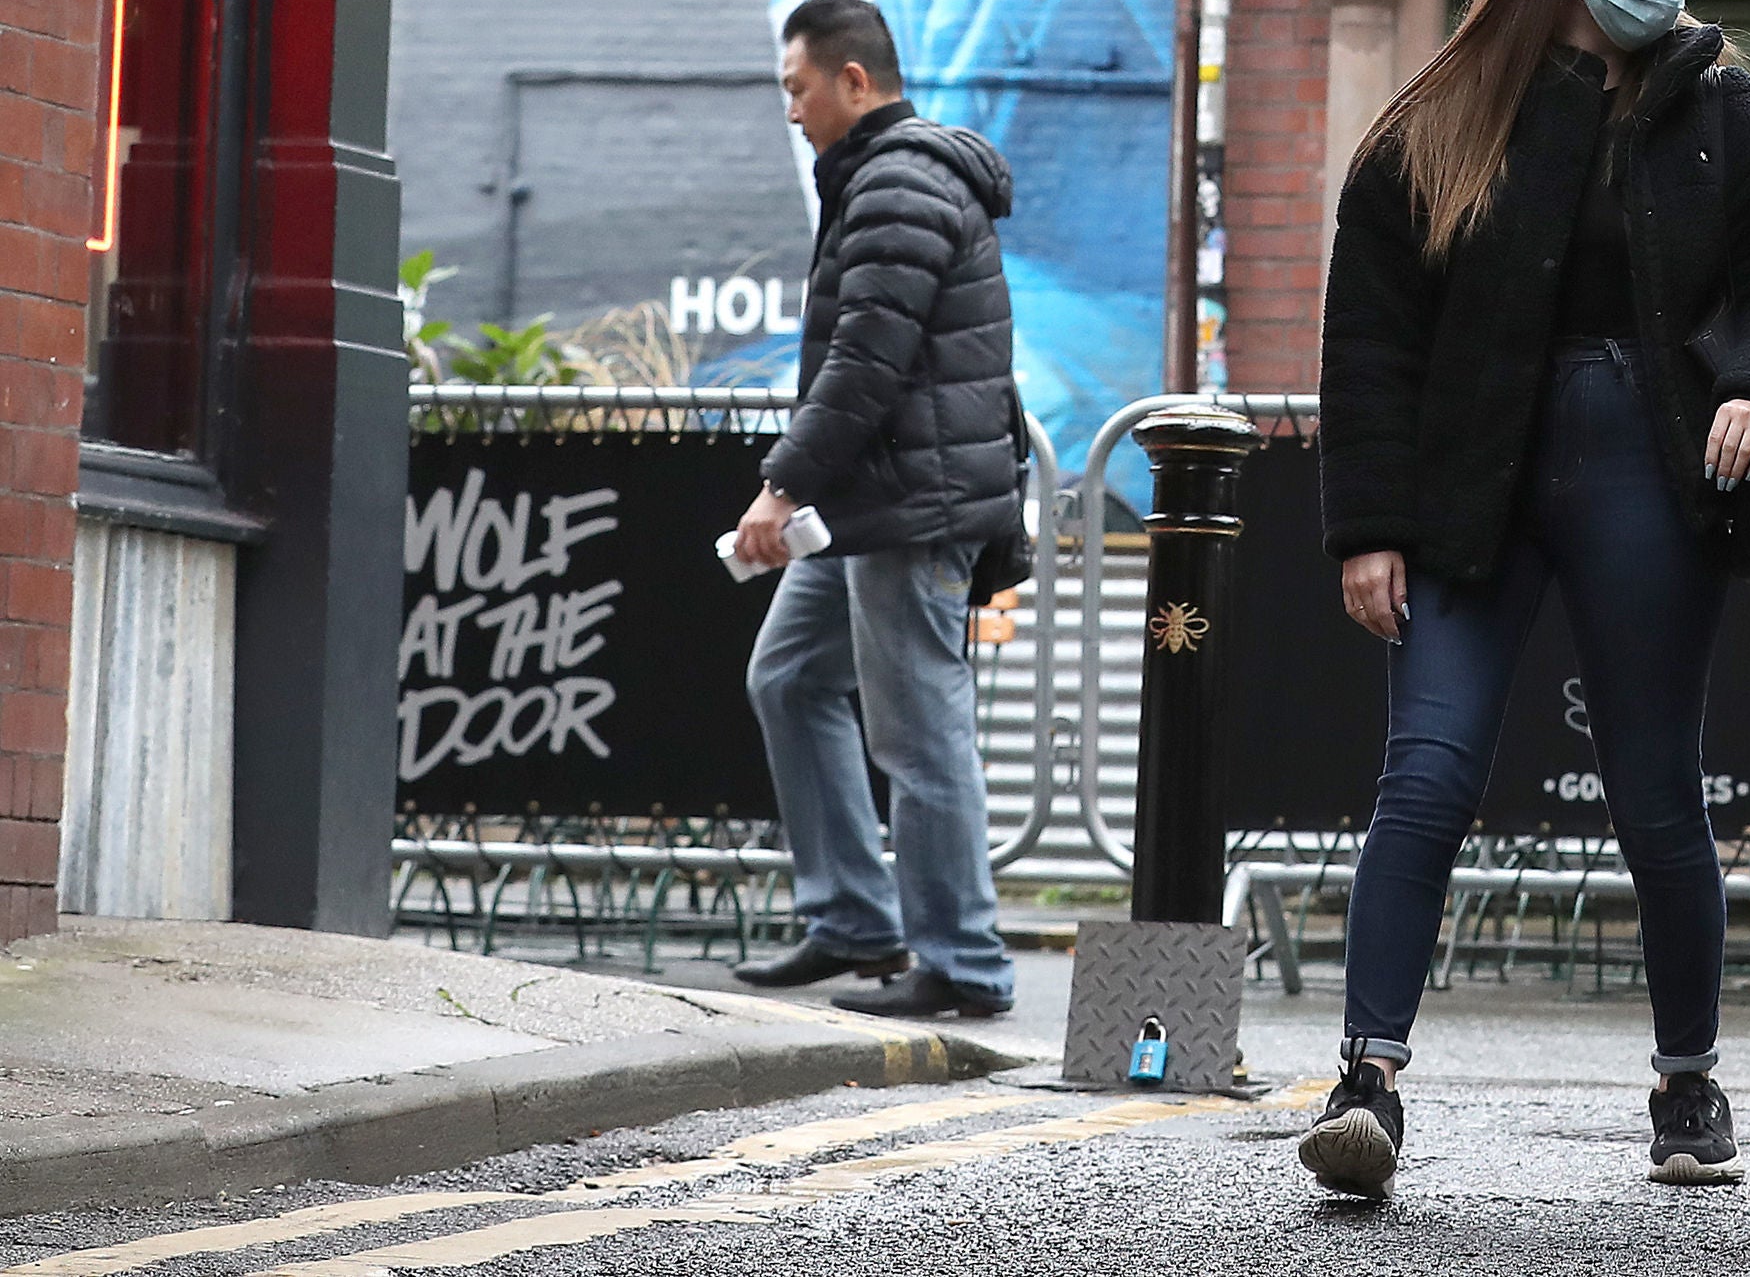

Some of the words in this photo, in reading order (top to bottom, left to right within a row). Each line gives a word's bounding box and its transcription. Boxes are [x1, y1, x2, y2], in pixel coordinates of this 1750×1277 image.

[670, 275, 809, 335] HOL
[403, 468, 619, 592] WOLF
[399, 594, 487, 679] AT
[475, 580, 623, 679] THE
[398, 676, 616, 782] DOOR
